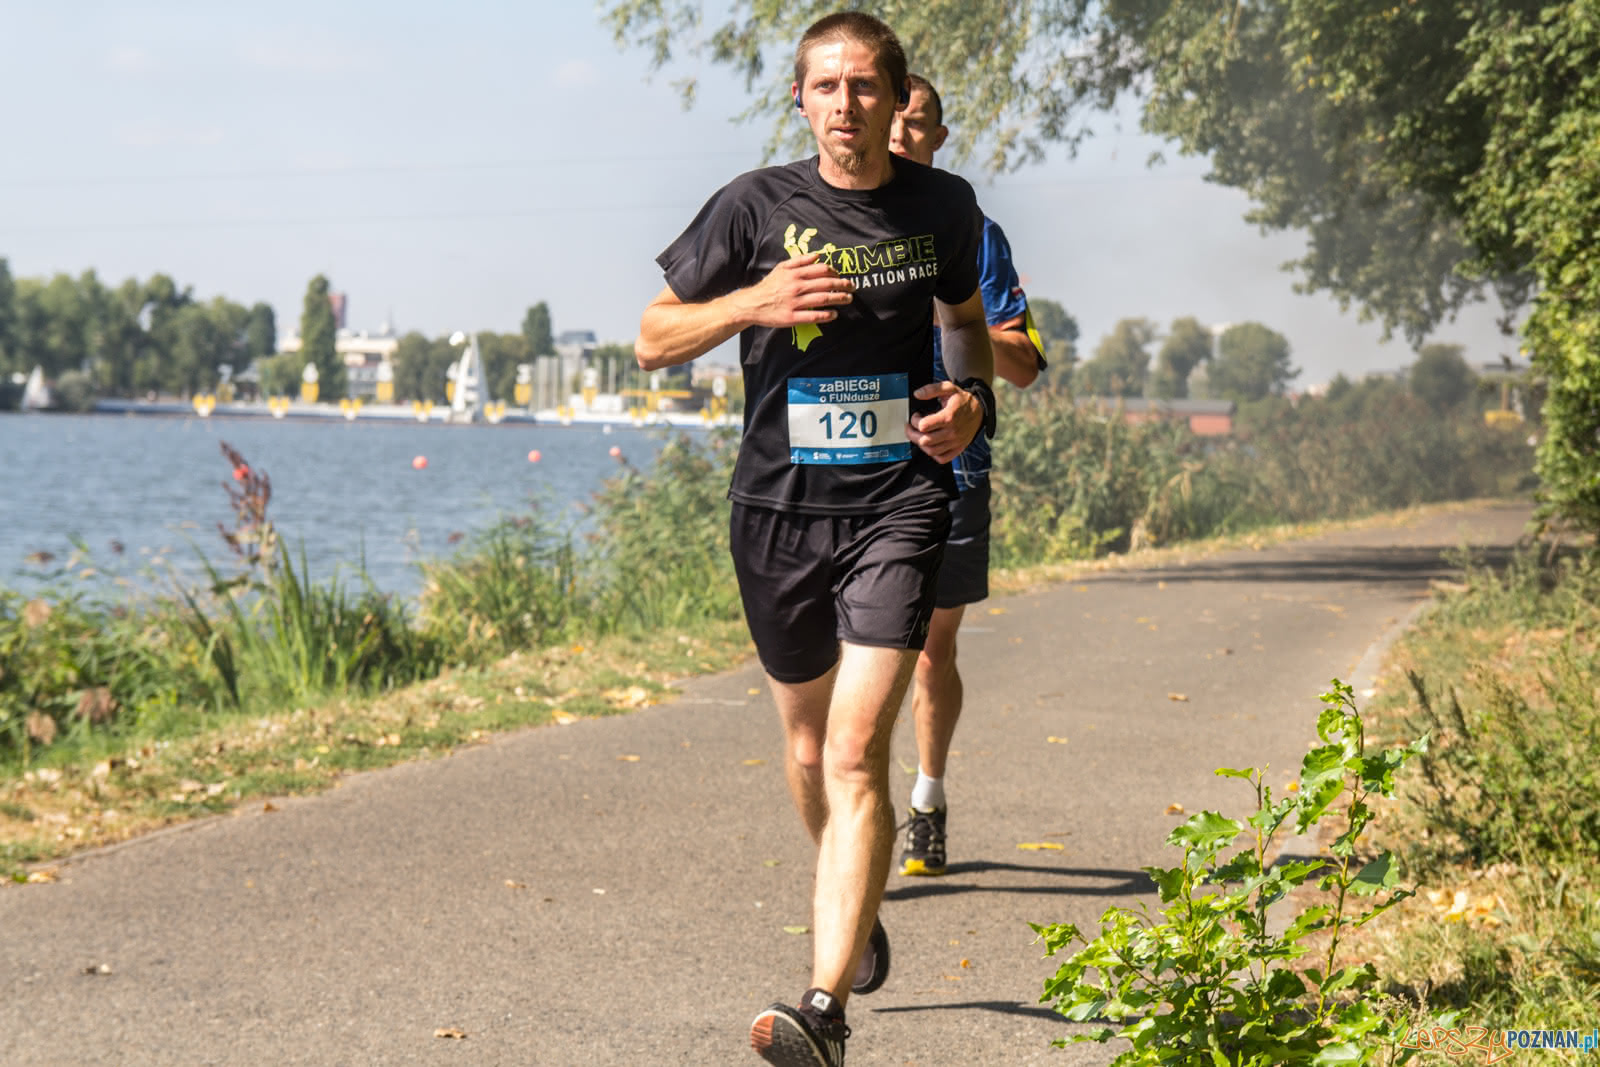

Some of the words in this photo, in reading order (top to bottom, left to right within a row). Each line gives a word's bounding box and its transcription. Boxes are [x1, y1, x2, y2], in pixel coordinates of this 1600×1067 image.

[850, 269, 905, 290] UATION
[910, 263, 938, 281] RACE
[819, 378, 880, 393] zaBIEGaj
[819, 395, 827, 403] o
[829, 392, 880, 403] FUNdusze
[819, 410, 877, 439] 120
